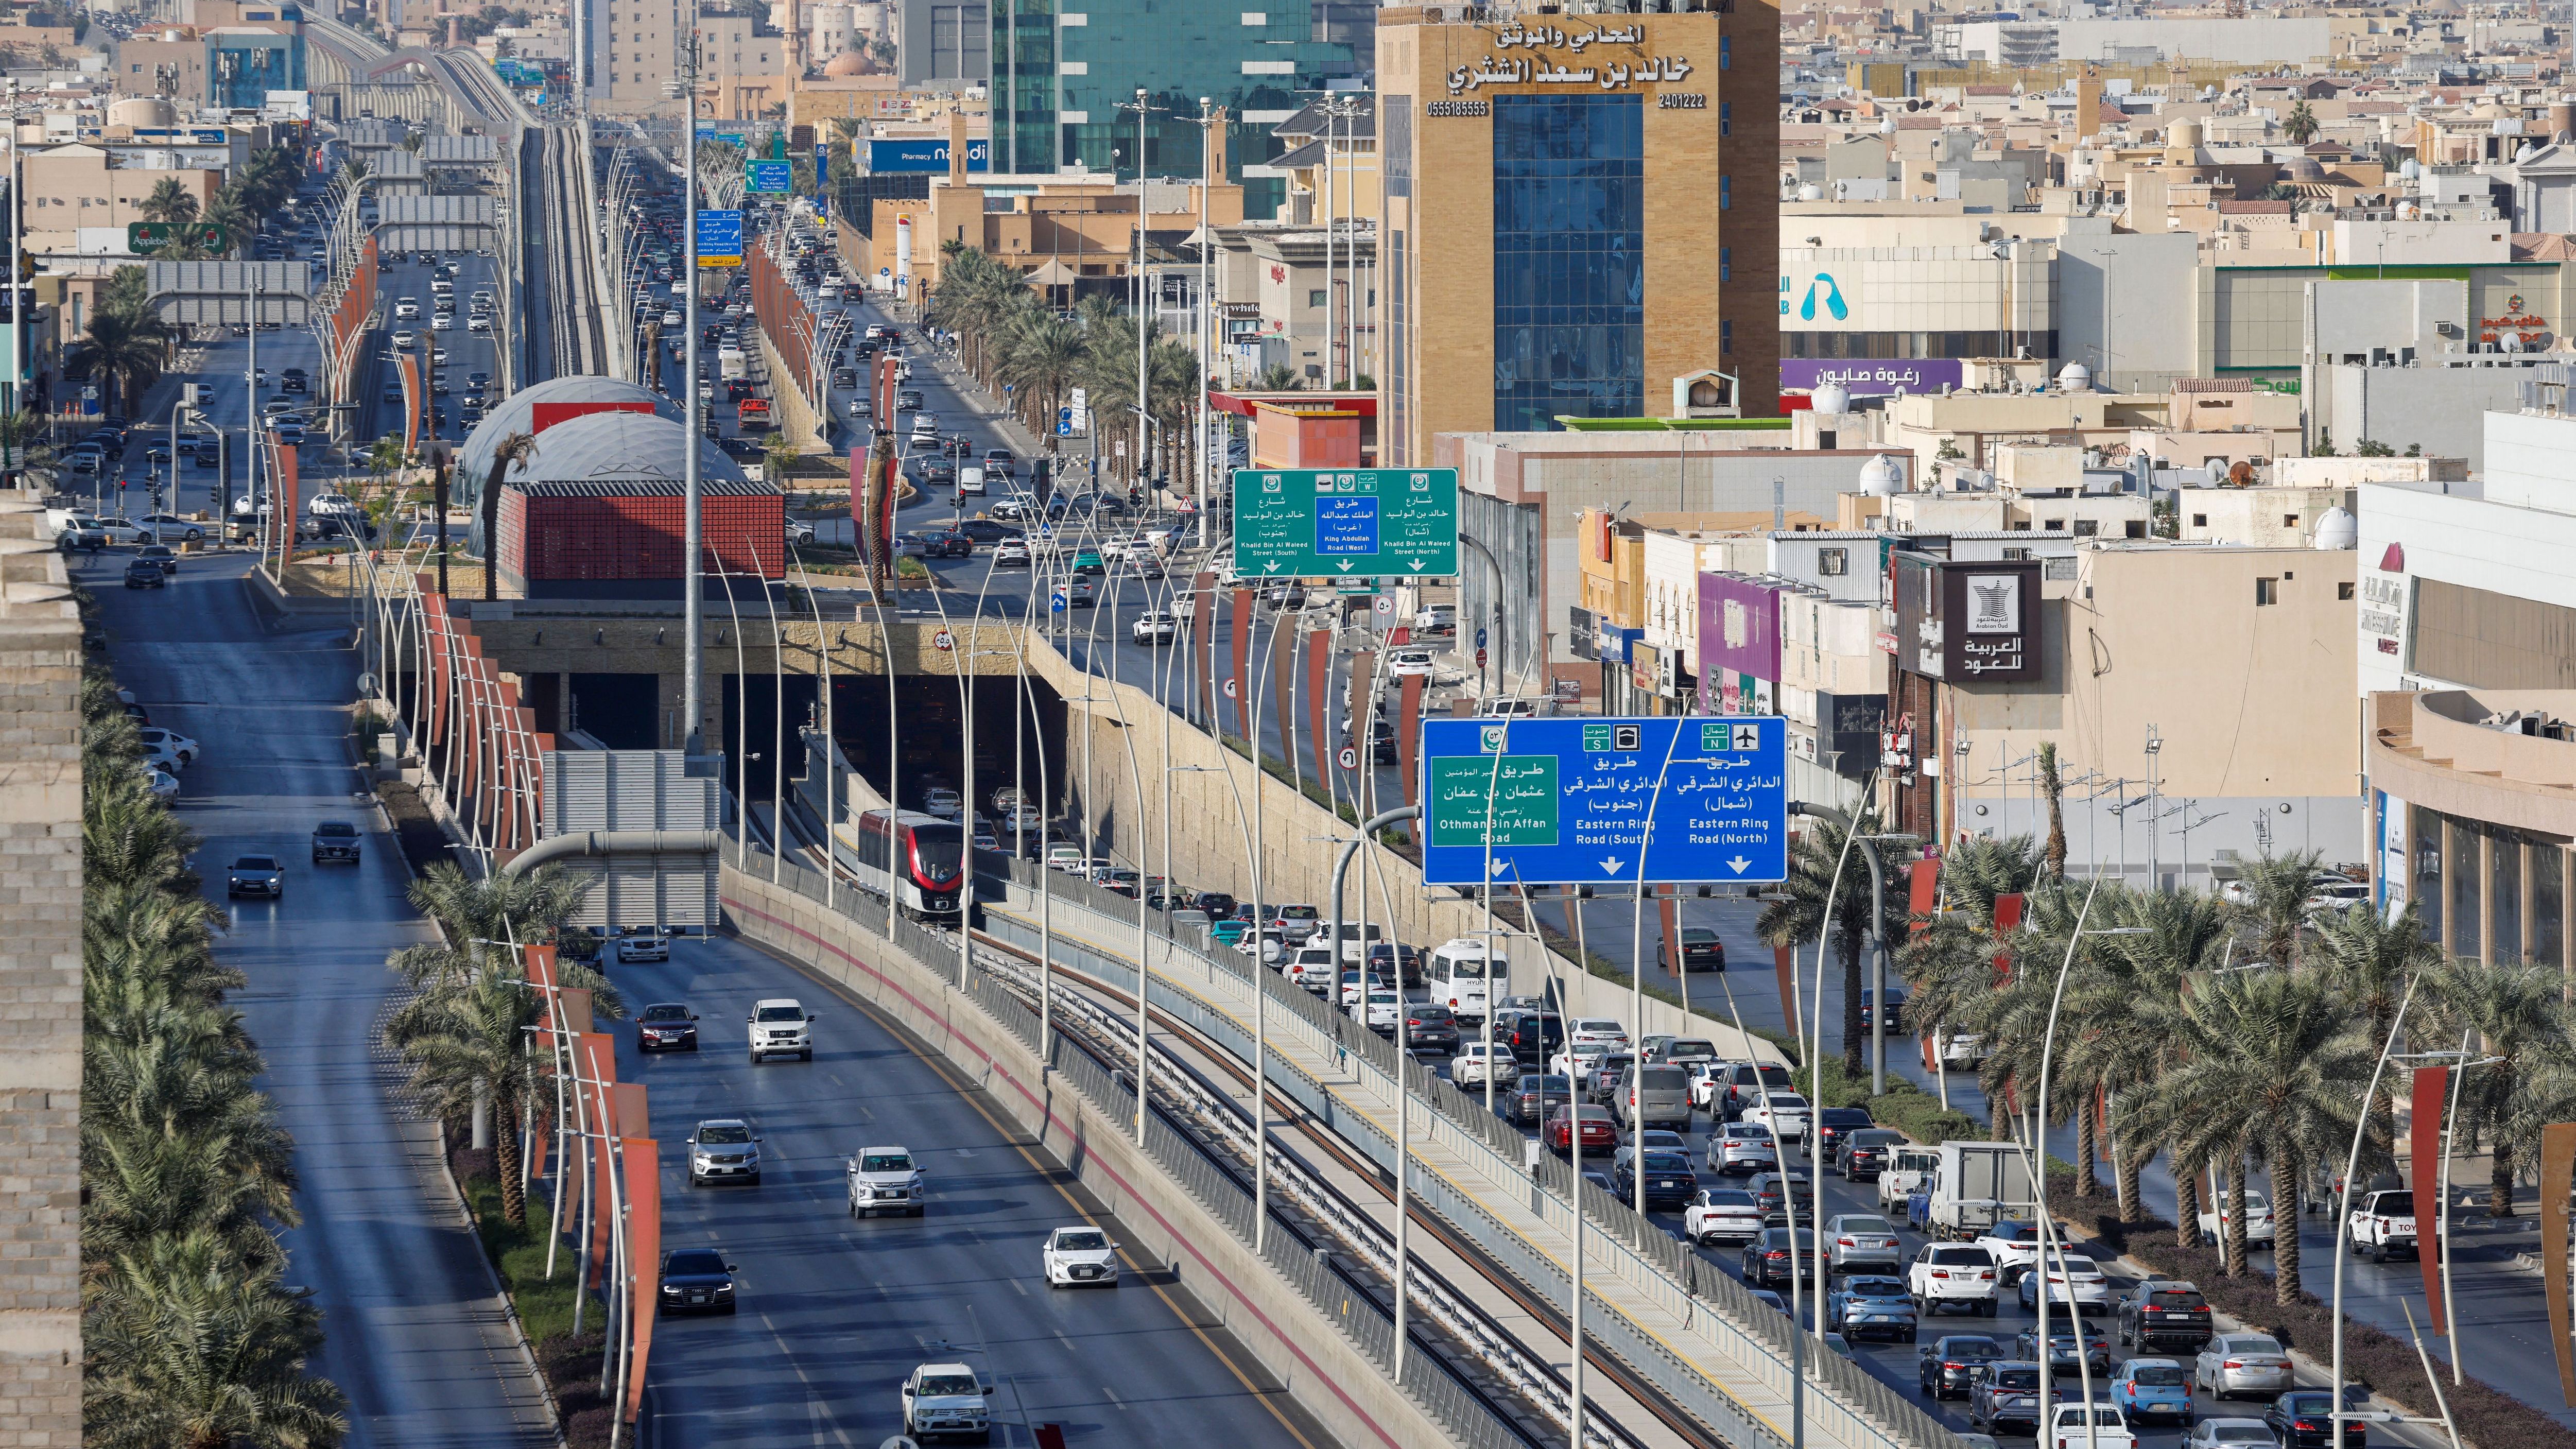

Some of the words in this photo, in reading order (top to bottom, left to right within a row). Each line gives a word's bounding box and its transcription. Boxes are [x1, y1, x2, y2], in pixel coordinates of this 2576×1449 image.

[1495, 22, 1563, 49] والموثق
[1568, 25, 1645, 53] المحامي
[1448, 54, 1531, 95] الشثري
[1536, 60, 1594, 83] سعد
[1601, 61, 1628, 89] بن
[1634, 56, 1692, 82] خالد
[1658, 93, 1703, 108] 2401222
[1426, 101, 1485, 116] 0555185555
[1, 291, 27, 306] KC
[1816, 367, 1872, 385] صابون
[1875, 367, 1921, 385] رغوة
[1259, 496, 1286, 508] شارع
[1335, 499, 1359, 508] طريق
[1406, 495, 1433, 507] شارع
[1243, 511, 1272, 521] الوليد
[1321, 511, 1349, 520] عبدالله
[1386, 509, 1415, 519] الوليد
[1405, 527, 1429, 536] (شمال)
[1965, 637, 2021, 656] العربية
[1965, 655, 2021, 674] للعود
[1705, 727, 1726, 735] شمال
[1593, 740, 1601, 749] S
[1711, 739, 1719, 748] N
[1594, 755, 1637, 771] طريق
[1445, 768, 1478, 777] المؤمنين
[1501, 763, 1544, 779] طريق
[1564, 776, 1615, 796] الشرقي
[1677, 775, 1727, 795] الشرقي
[1731, 775, 1780, 792] الدائري
[1444, 785, 1478, 800] عفان
[1505, 784, 1545, 800] عثمان
[1588, 798, 1643, 813] (جنوب)
[1705, 796, 1752, 812] (شمال)
[1440, 819, 1486, 829] Othman
[1513, 819, 1546, 828] Affan
[1576, 819, 1624, 829] Eastern
[1689, 819, 1738, 829] Eastern
[1742, 818, 1769, 830] Ring
[1576, 835, 1605, 844] Road
[1689, 834, 1719, 843] Road
[1721, 833, 1768, 845] (North)
